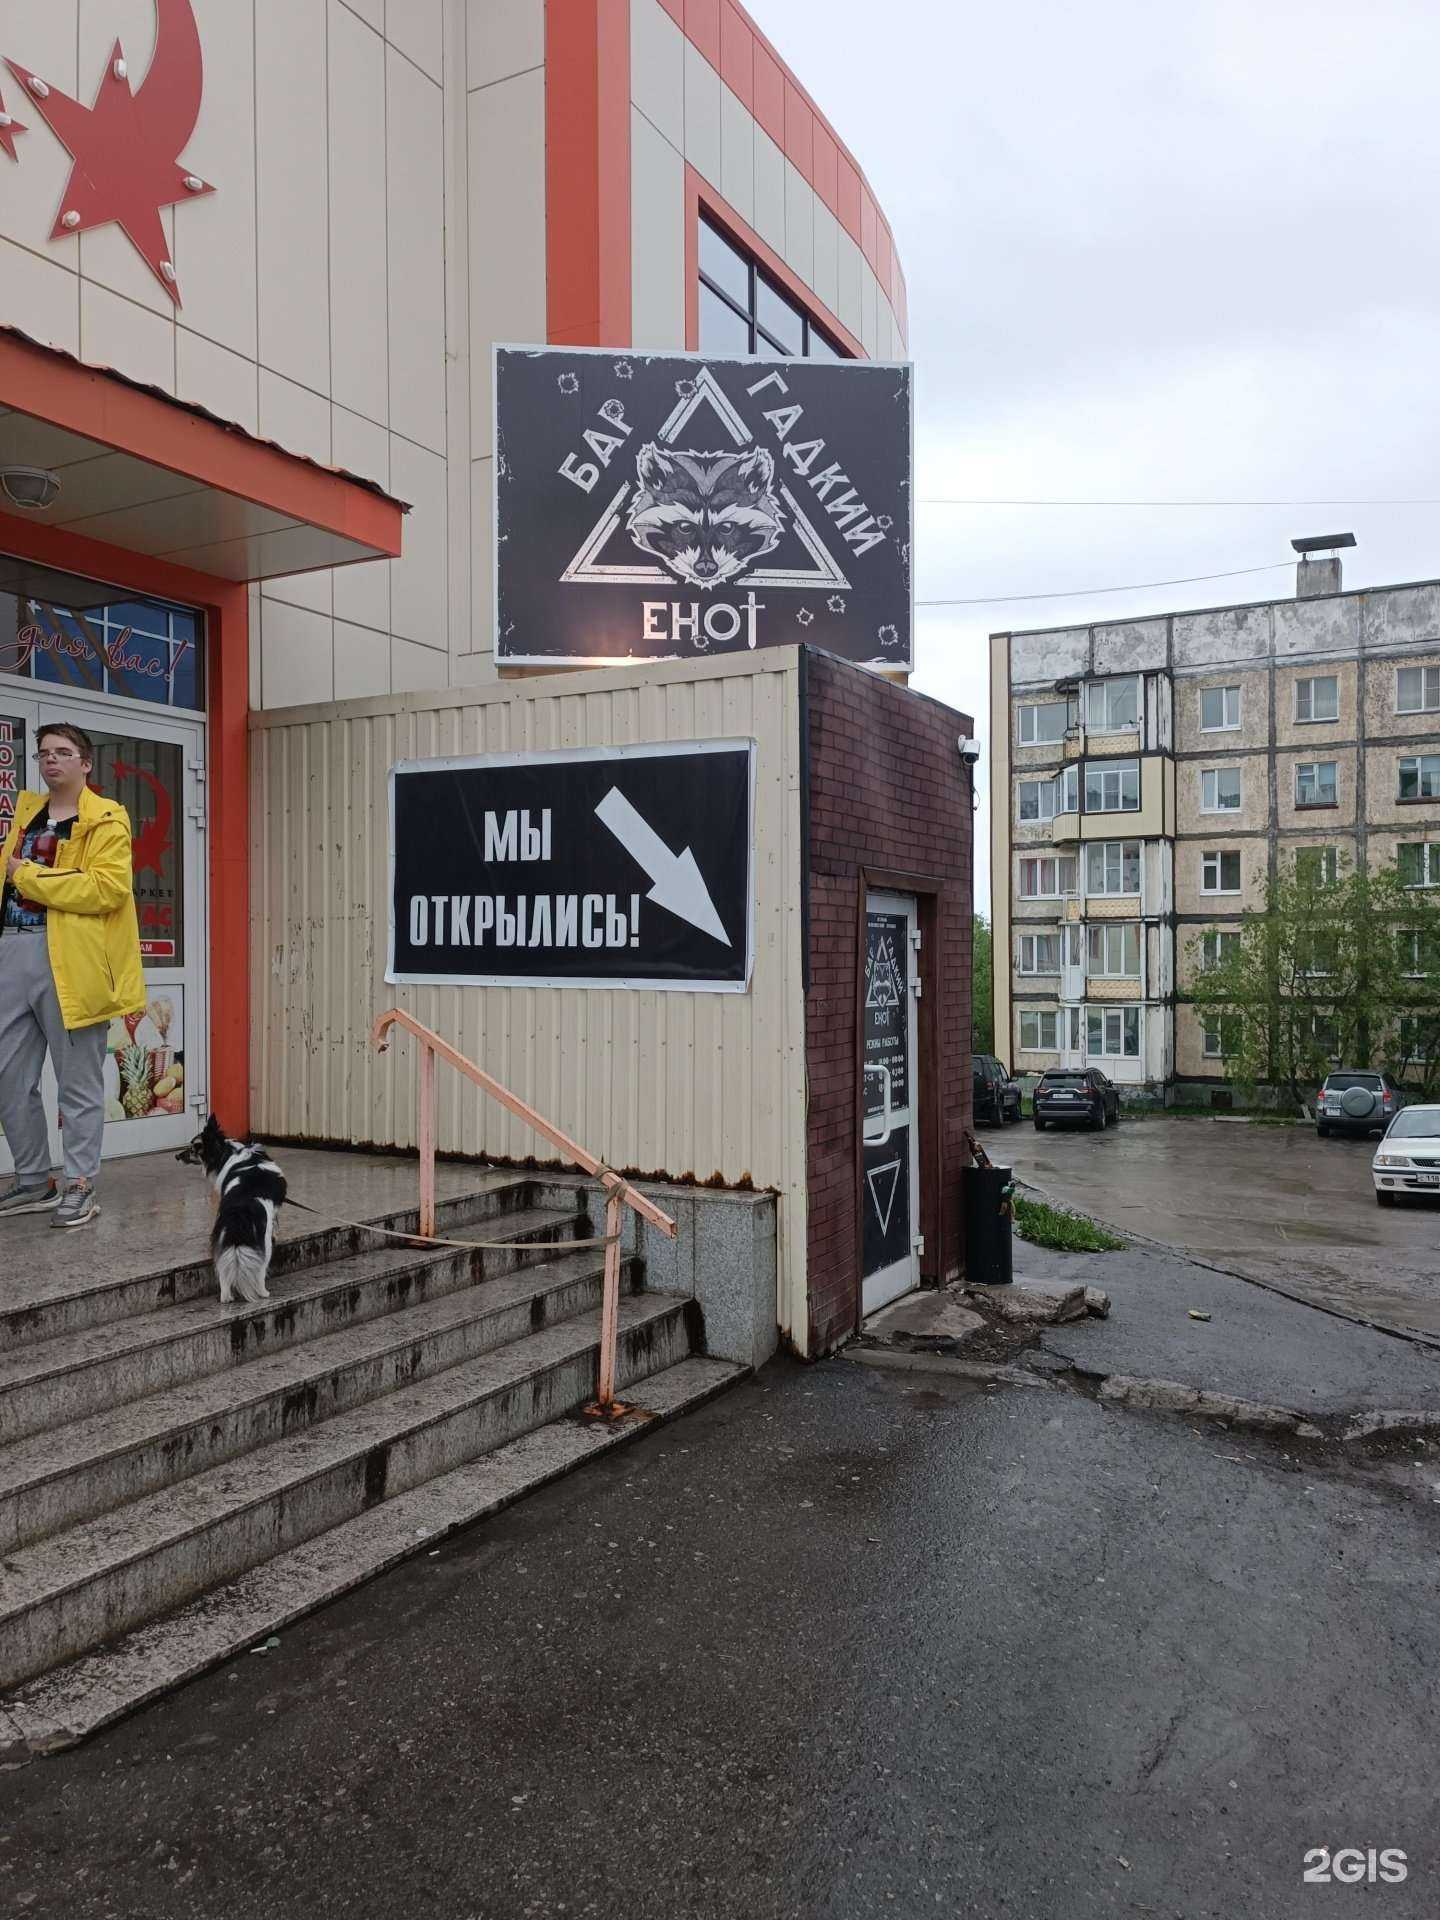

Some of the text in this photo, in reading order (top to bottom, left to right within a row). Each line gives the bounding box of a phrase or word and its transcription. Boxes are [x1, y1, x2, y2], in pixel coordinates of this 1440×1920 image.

[557, 399, 634, 494] БАР
[747, 370, 893, 558] ГАДКИЙ
[642, 592, 765, 650] ЕНОТ
[0, 624, 188, 682] для вас!
[0, 720, 17, 855] ПОЖАЛ
[484, 808, 551, 862] МЫ
[409, 893, 640, 948] ОТКРЫЛИСЬ!
